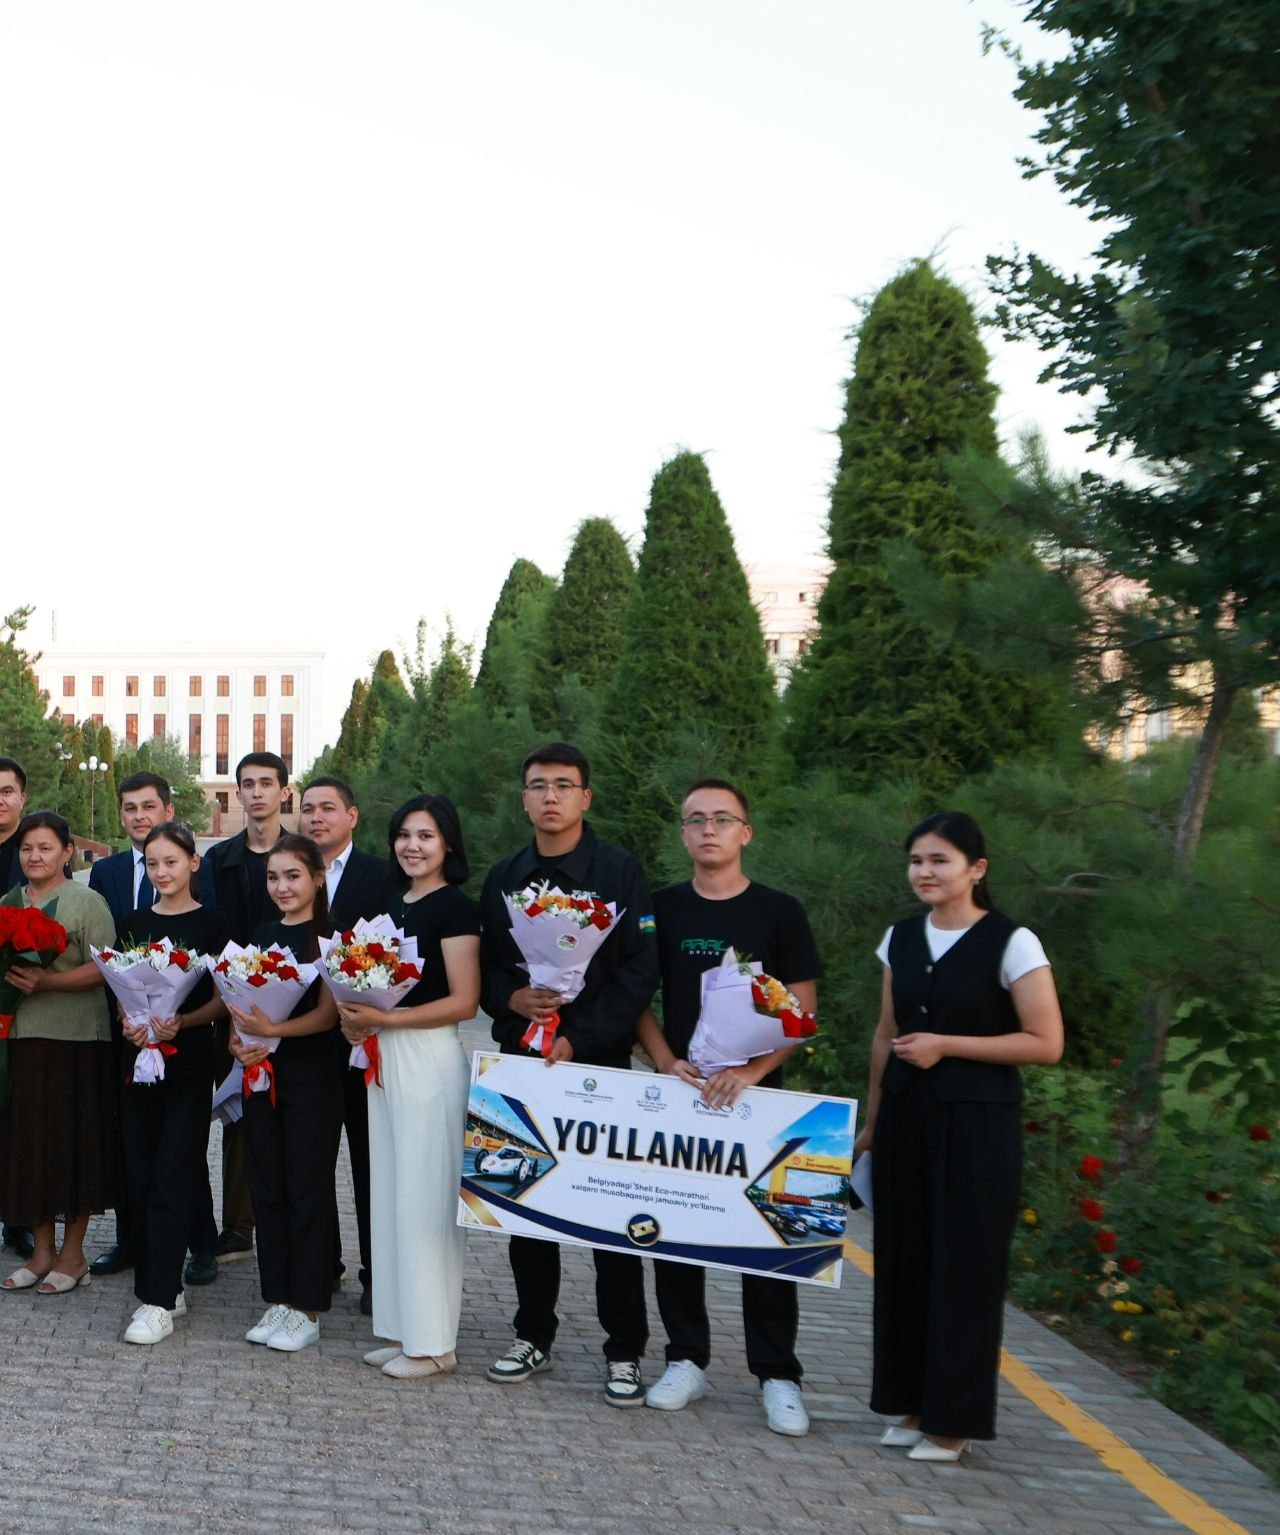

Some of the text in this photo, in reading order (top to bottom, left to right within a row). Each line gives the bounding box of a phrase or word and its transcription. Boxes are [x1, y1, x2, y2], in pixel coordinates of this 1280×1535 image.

[588, 1176, 632, 1190] Belgiyadagi
[571, 1184, 599, 1195] xalqaro
[600, 1187, 654, 1202] musobaqasiga
[655, 1195, 688, 1209] jamoaviy
